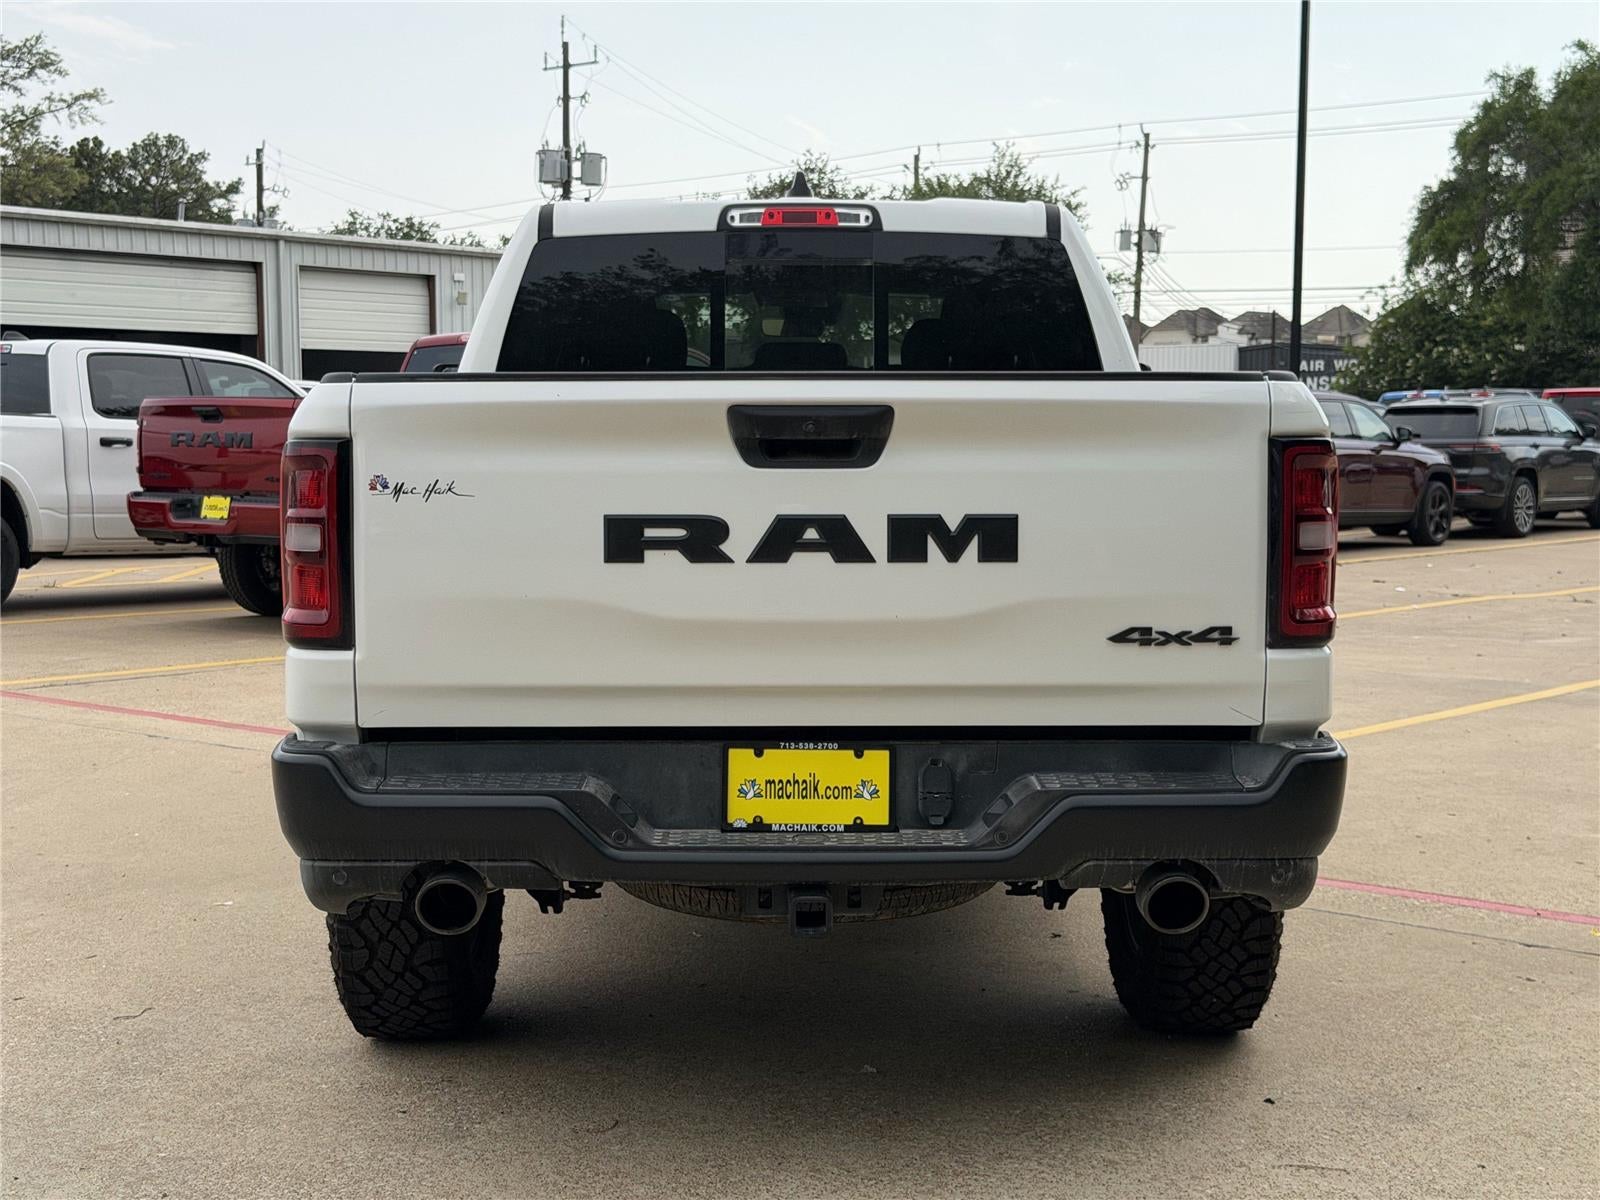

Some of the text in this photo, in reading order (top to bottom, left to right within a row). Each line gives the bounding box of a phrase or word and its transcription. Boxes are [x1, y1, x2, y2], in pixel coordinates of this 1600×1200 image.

[170, 431, 253, 449] RAM
[389, 479, 475, 503] Mac Haik
[603, 513, 1019, 563] RAM
[1106, 625, 1241, 647] 4x4
[779, 742, 839, 750] 713-538-2700
[764, 772, 853, 800] machaik.com
[771, 823, 845, 832] MACHAIK.COM
